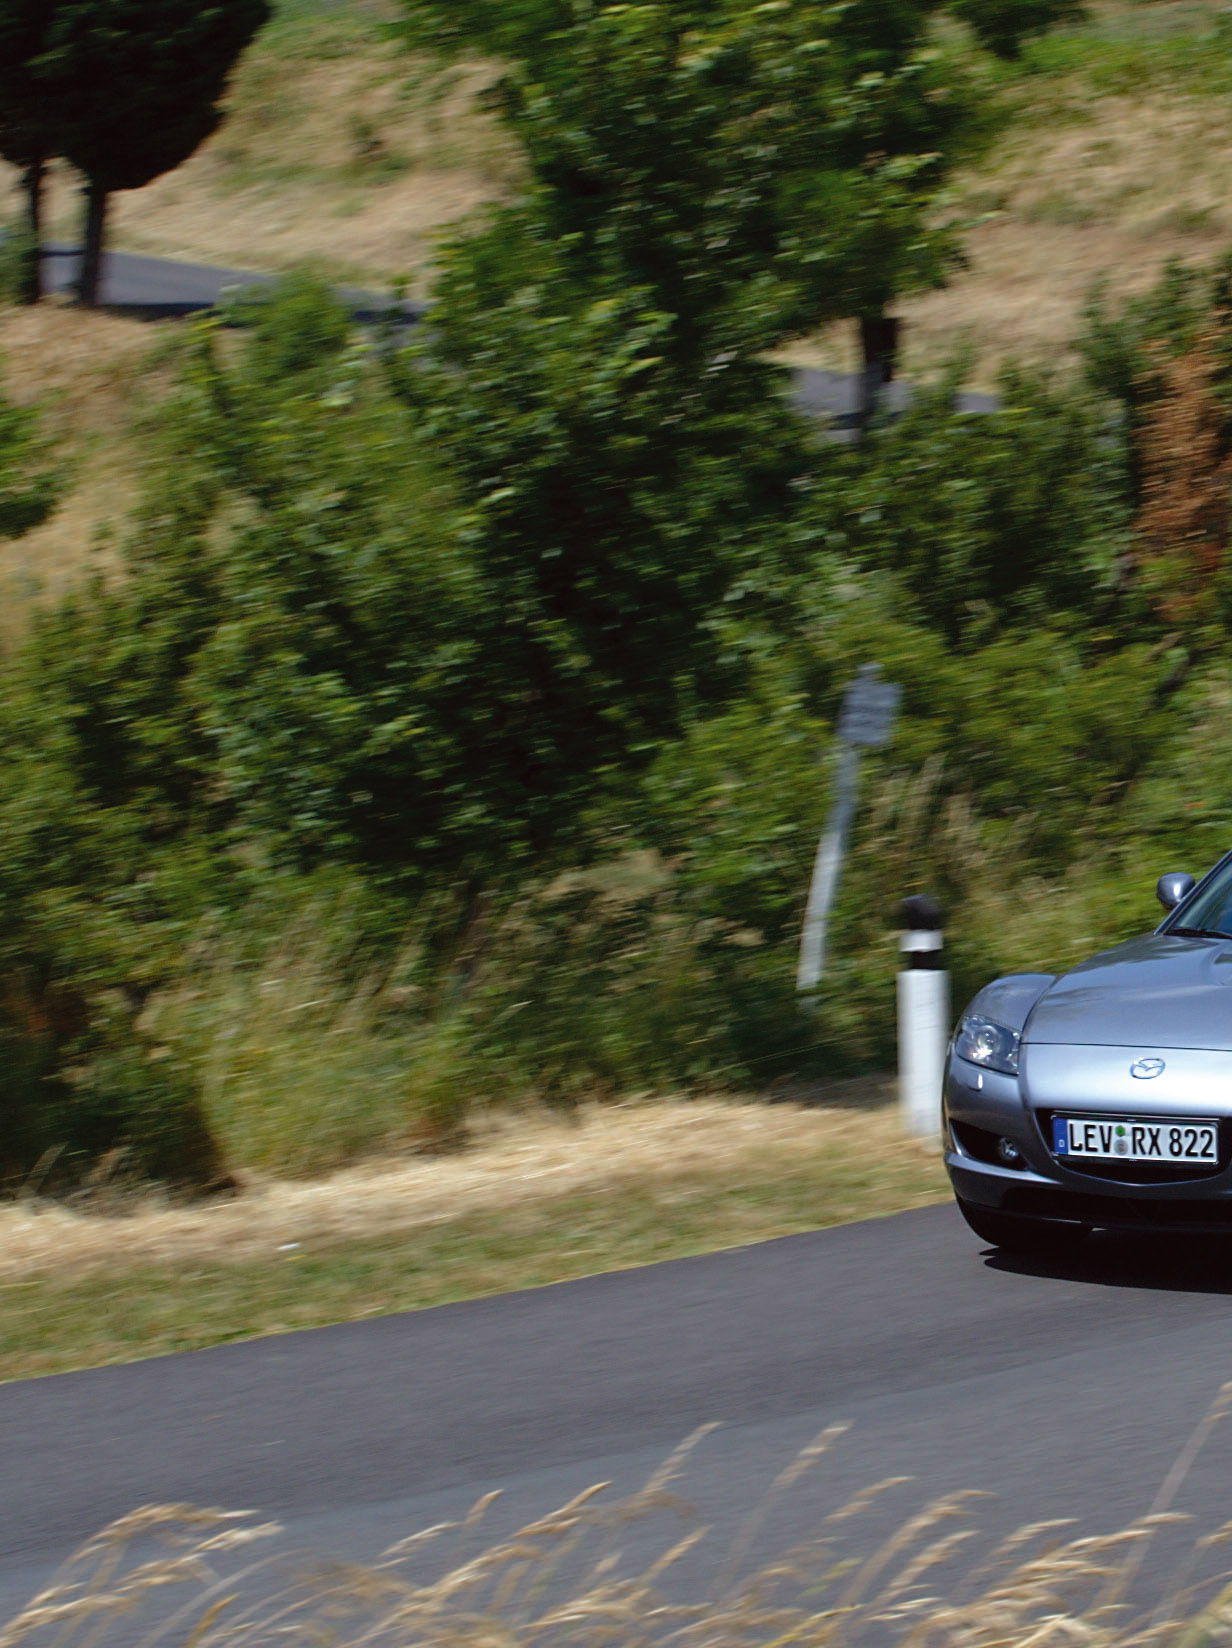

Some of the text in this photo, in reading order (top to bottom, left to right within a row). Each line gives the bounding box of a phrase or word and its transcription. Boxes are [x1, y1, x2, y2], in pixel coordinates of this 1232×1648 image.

[1069, 1123, 1215, 1158] LEV RX 822
